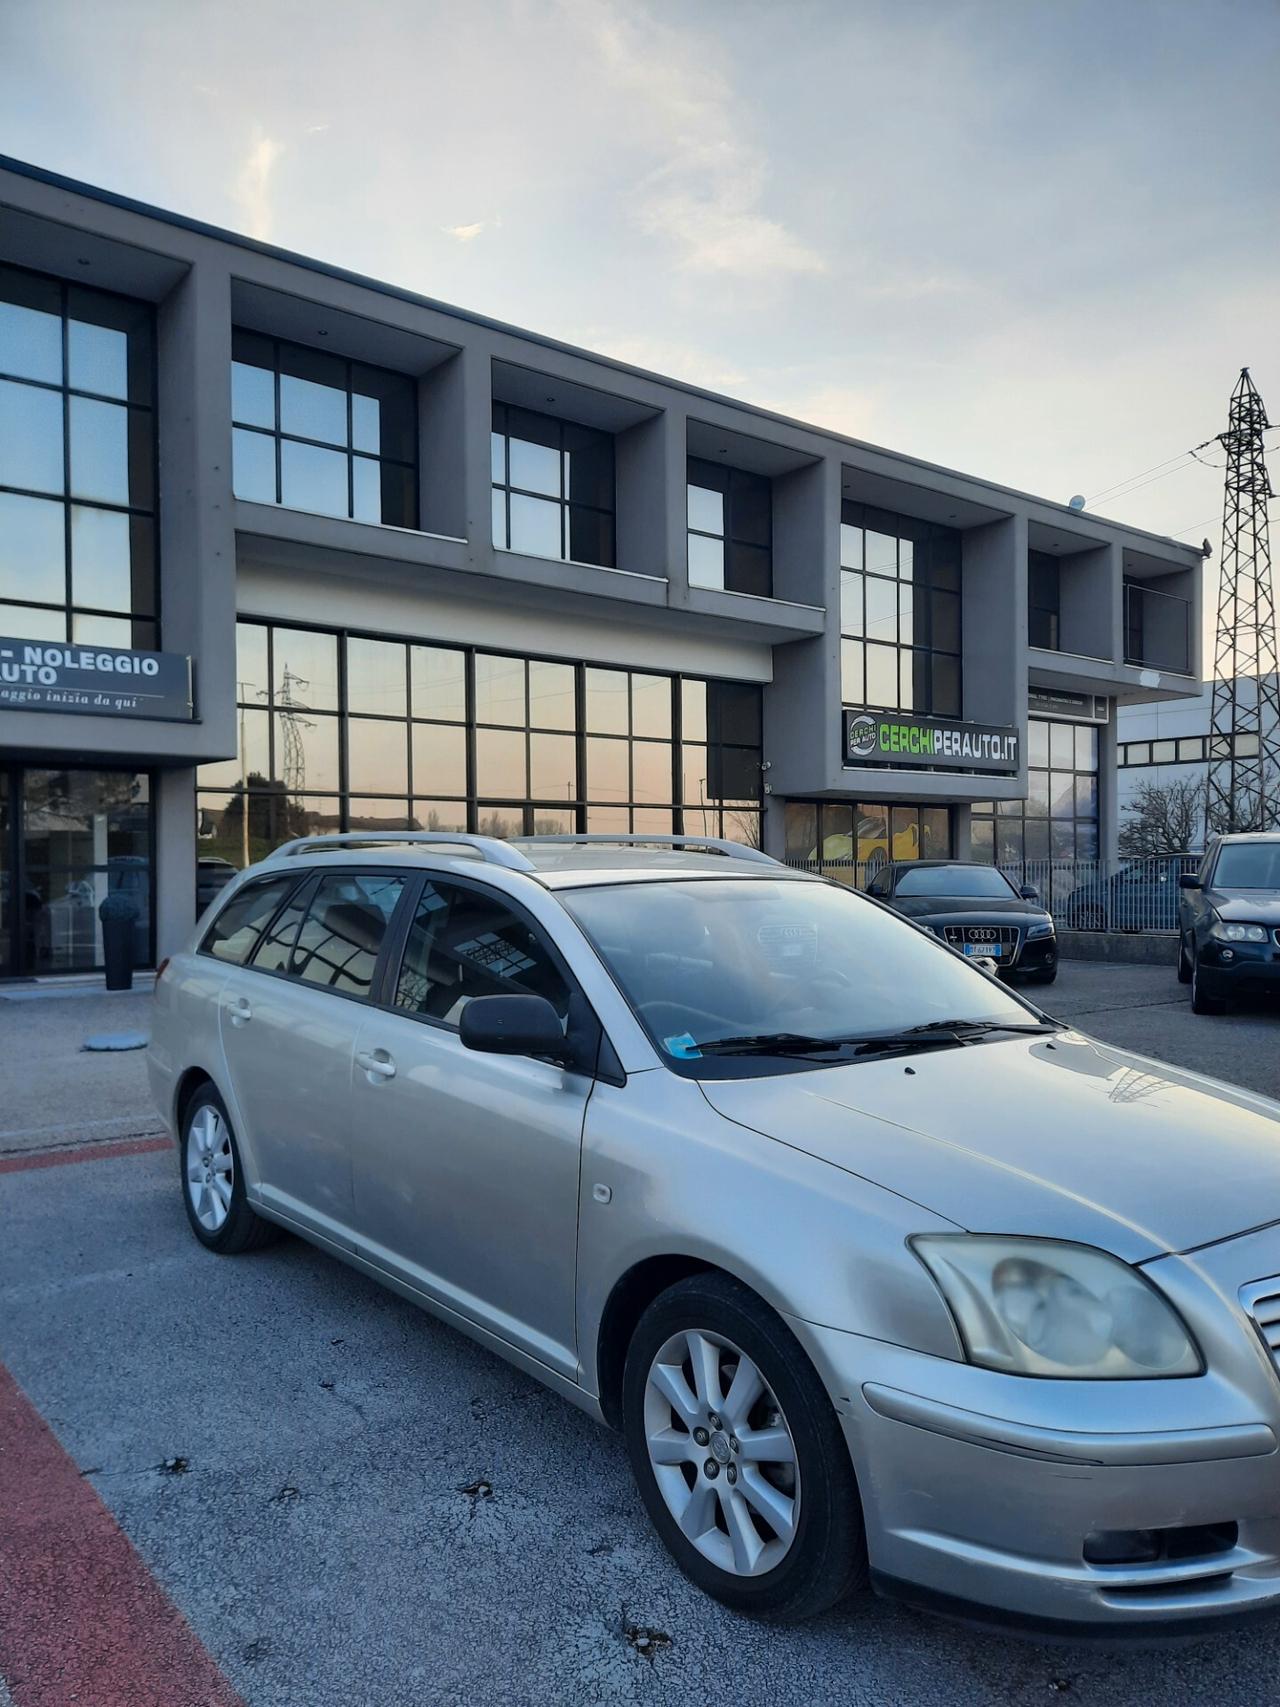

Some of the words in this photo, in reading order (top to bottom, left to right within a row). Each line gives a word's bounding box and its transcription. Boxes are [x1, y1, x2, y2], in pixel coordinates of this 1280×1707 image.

[24, 646, 159, 676] NOLEGGIO
[0, 662, 58, 685] UTO
[46, 690, 90, 704] inizia
[94, 694, 110, 705] da
[850, 724, 876, 739] CERCHI
[850, 737, 861, 746] PER
[880, 723, 1017, 760] CERCHIPERAUTO.IT
